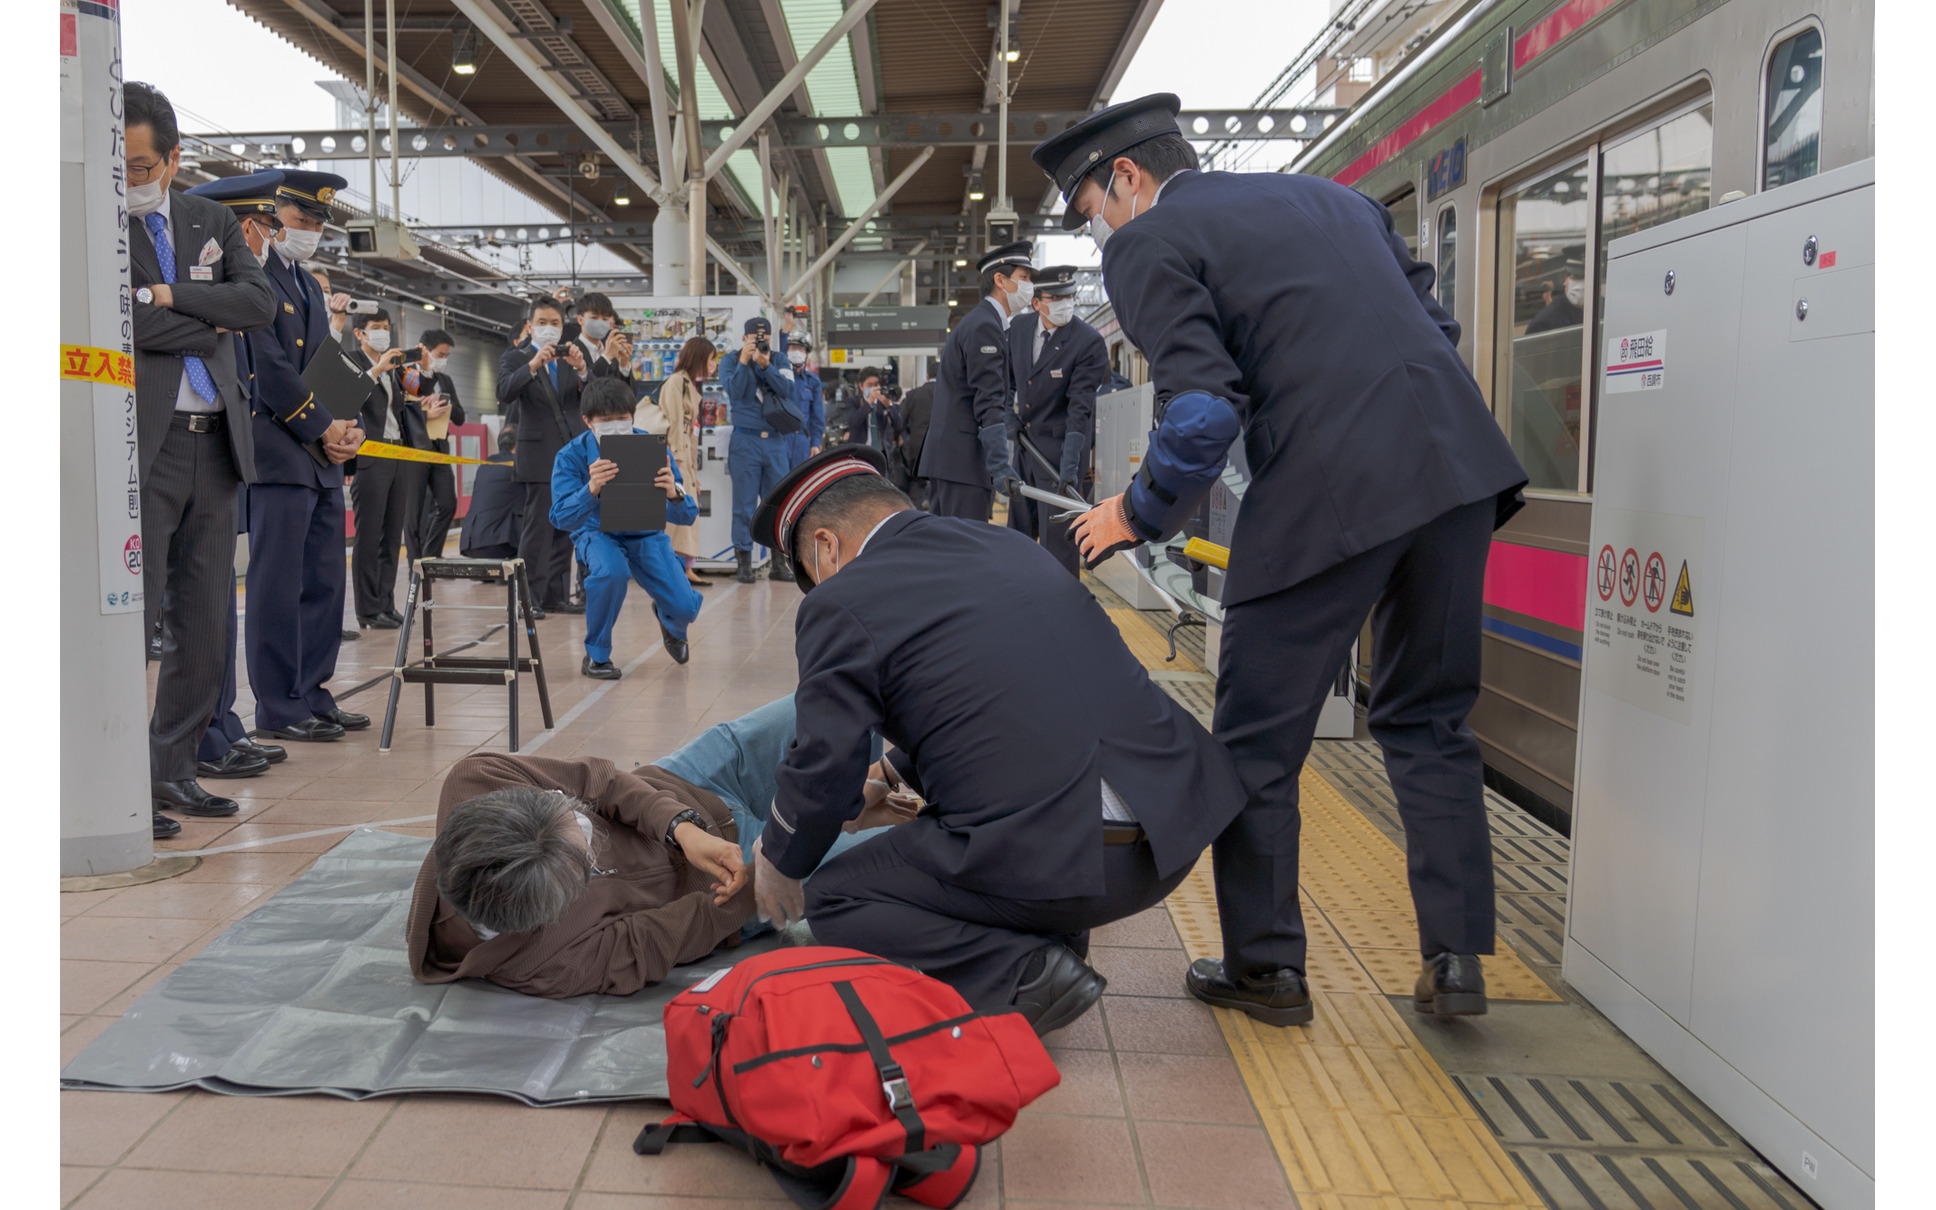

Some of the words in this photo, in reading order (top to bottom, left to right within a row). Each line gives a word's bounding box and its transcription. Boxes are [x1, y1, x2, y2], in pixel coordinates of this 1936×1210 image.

[1428, 140, 1465, 197] KEIO
[834, 309, 841, 318] 3
[1629, 336, 1654, 360] 飛田給
[130, 538, 141, 549] KO
[129, 551, 141, 568] 20
